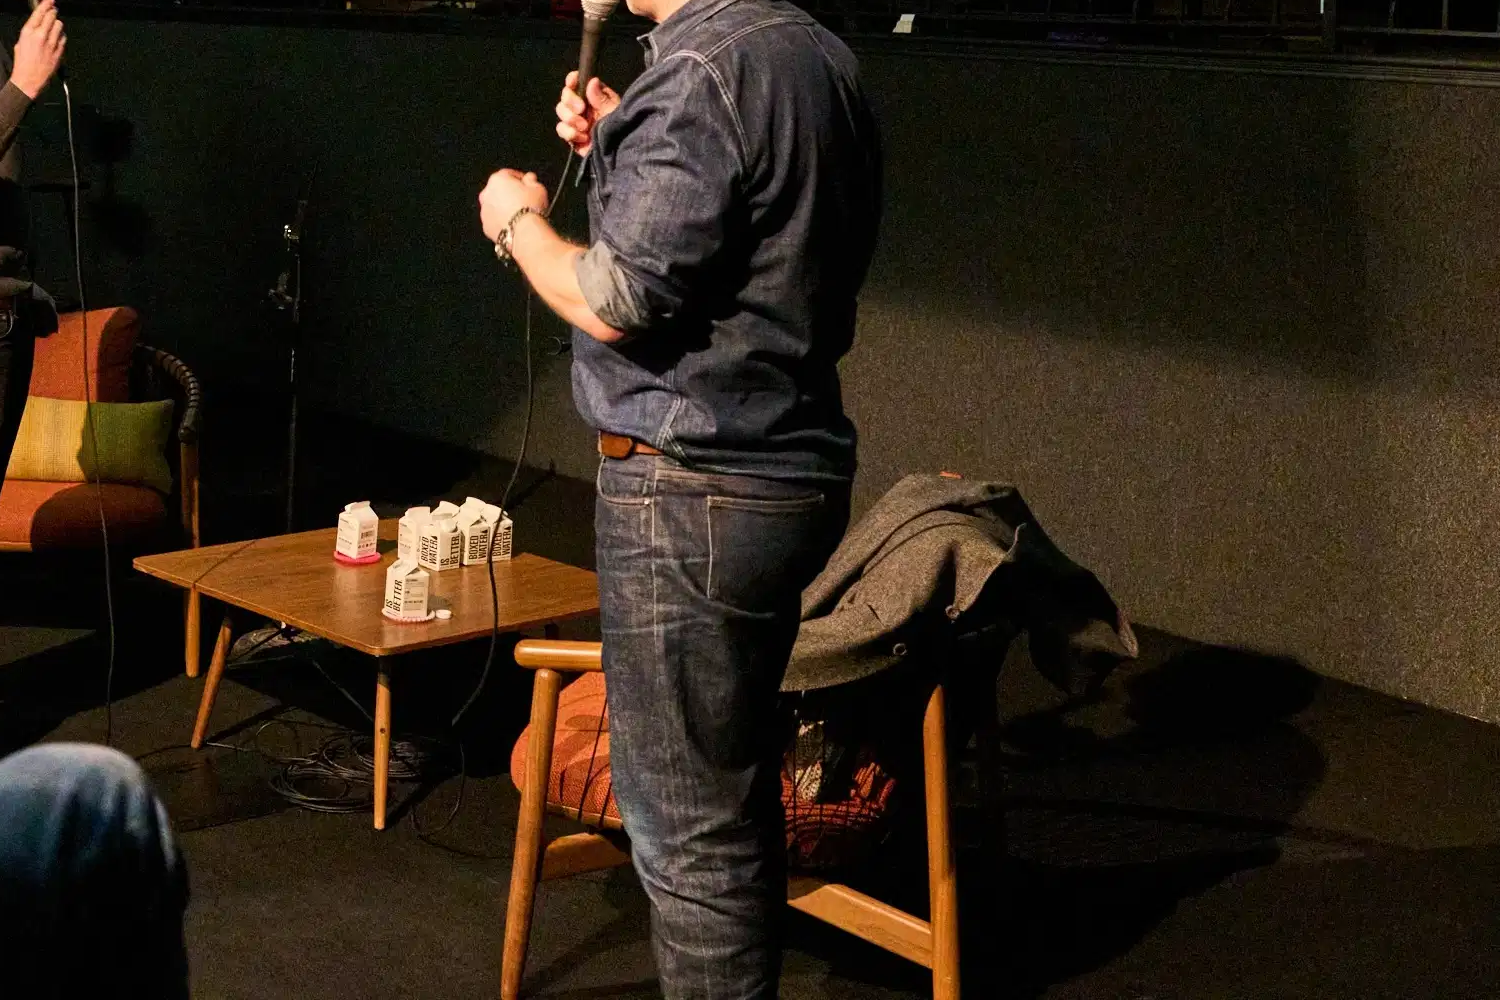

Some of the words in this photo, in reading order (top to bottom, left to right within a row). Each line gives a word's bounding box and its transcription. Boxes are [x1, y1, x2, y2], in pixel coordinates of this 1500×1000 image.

[420, 536, 430, 562] BOXED
[429, 538, 438, 565] WATER
[450, 535, 460, 565] BETTER
[468, 535, 479, 560] BOXED
[478, 534, 488, 560] WATER
[502, 530, 512, 556] WATER
[440, 557, 450, 566] IS
[385, 598, 393, 609] IS
[393, 579, 403, 612] BETTER
